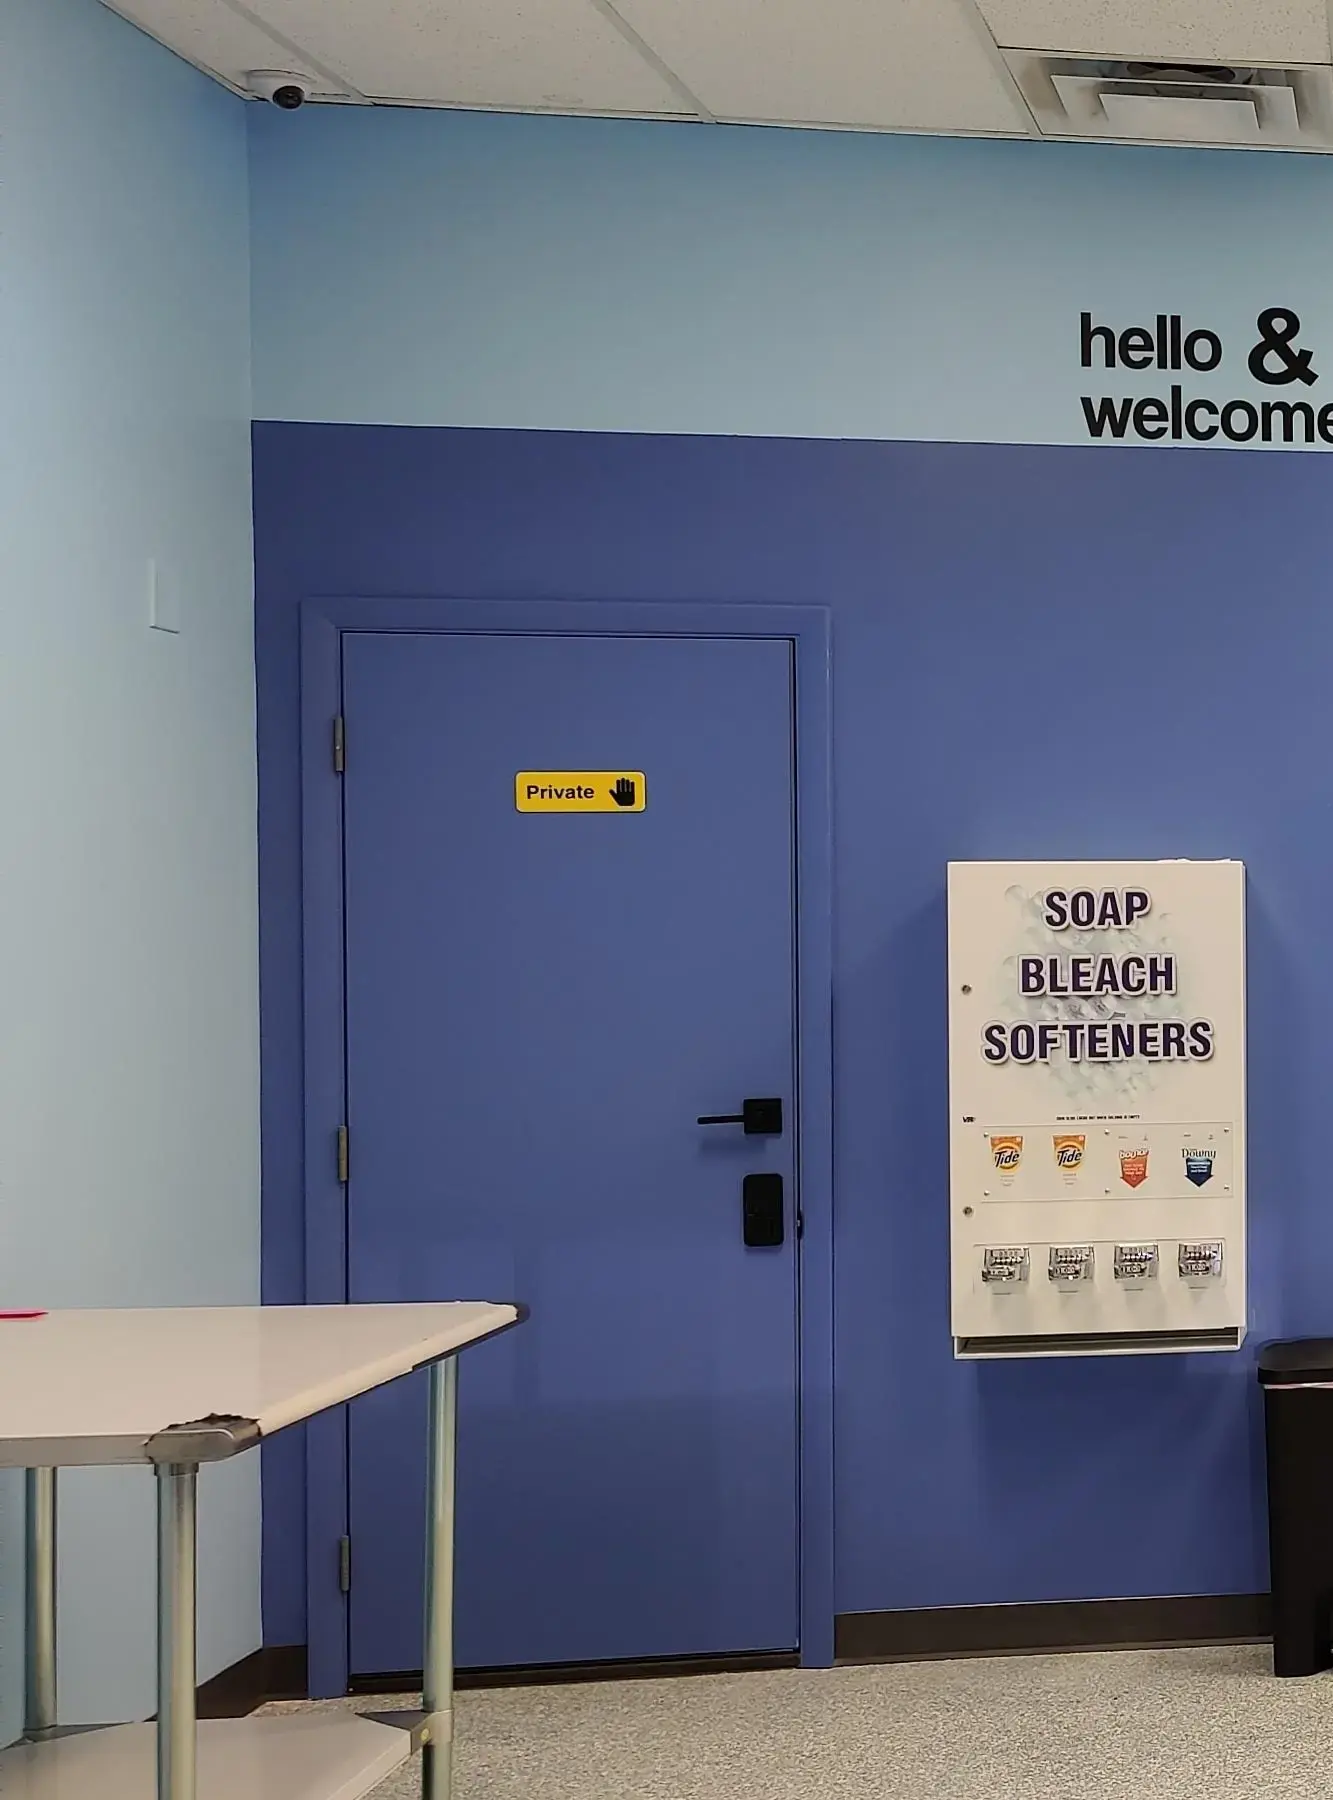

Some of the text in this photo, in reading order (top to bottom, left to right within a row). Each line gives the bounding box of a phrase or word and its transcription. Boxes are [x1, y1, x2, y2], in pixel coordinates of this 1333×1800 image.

[1080, 307, 1319, 386] hello &
[526, 785, 595, 799] Private
[1044, 890, 1149, 927] SOAP
[1019, 955, 1174, 993] BLEACH
[983, 1020, 1212, 1061] SOFTENERS
[995, 1150, 1020, 1168] Tide
[1057, 1149, 1082, 1167] Tide
[1181, 1147, 1217, 1159] Downy
